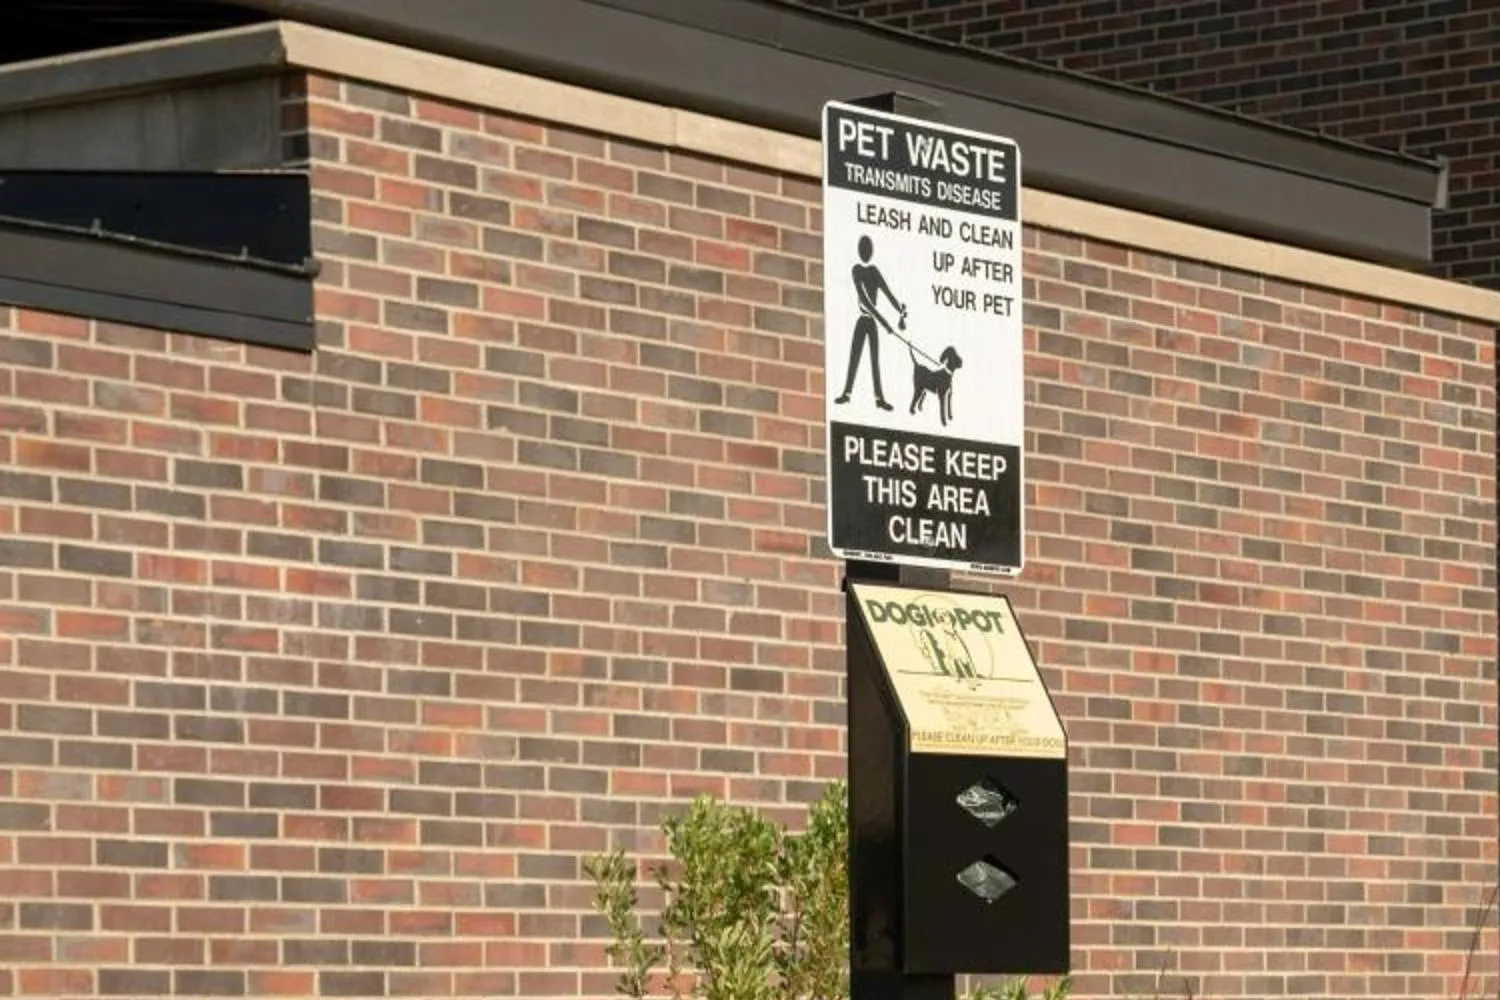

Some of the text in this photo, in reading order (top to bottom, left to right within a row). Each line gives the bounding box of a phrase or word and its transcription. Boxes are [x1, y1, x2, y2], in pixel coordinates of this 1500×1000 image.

[838, 118, 1006, 183] PET WASTE
[845, 162, 1001, 210] TRANSMITS DISEASE
[857, 201, 1013, 250] LEASH AND CLEAN
[933, 251, 1013, 284] UP AFTER
[932, 284, 1014, 317] YOUR PET
[845, 436, 1007, 481] PLEASE KEEP
[863, 475, 991, 516] THIS AREA
[888, 515, 967, 549] CLEAN
